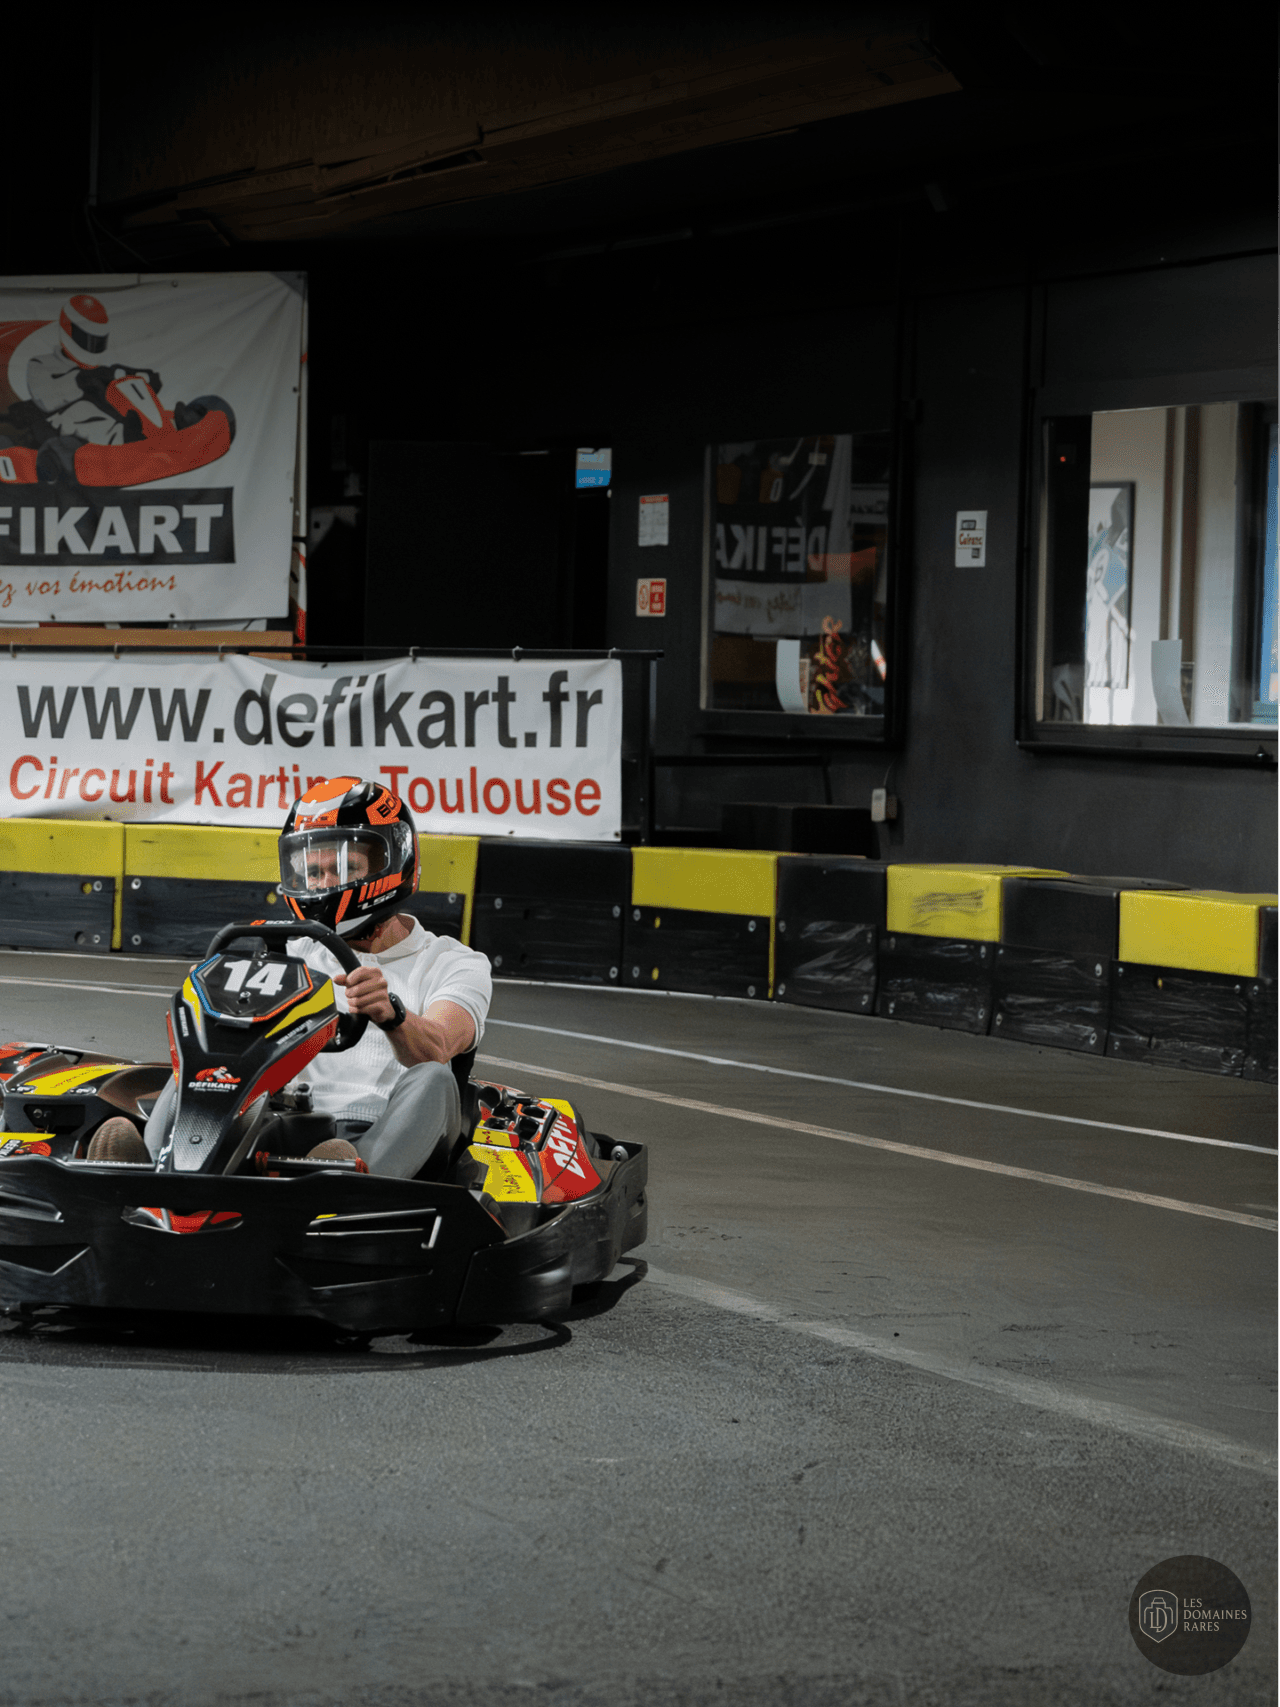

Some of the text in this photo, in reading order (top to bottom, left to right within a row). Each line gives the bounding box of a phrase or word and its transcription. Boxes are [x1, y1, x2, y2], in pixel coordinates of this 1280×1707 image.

[25, 576, 61, 596] vos
[69, 570, 178, 595] émotions
[16, 669, 603, 749] www.defikart.fr
[9, 755, 174, 806] Circuit
[379, 764, 602, 816] Toulouse
[223, 959, 288, 996] 14
